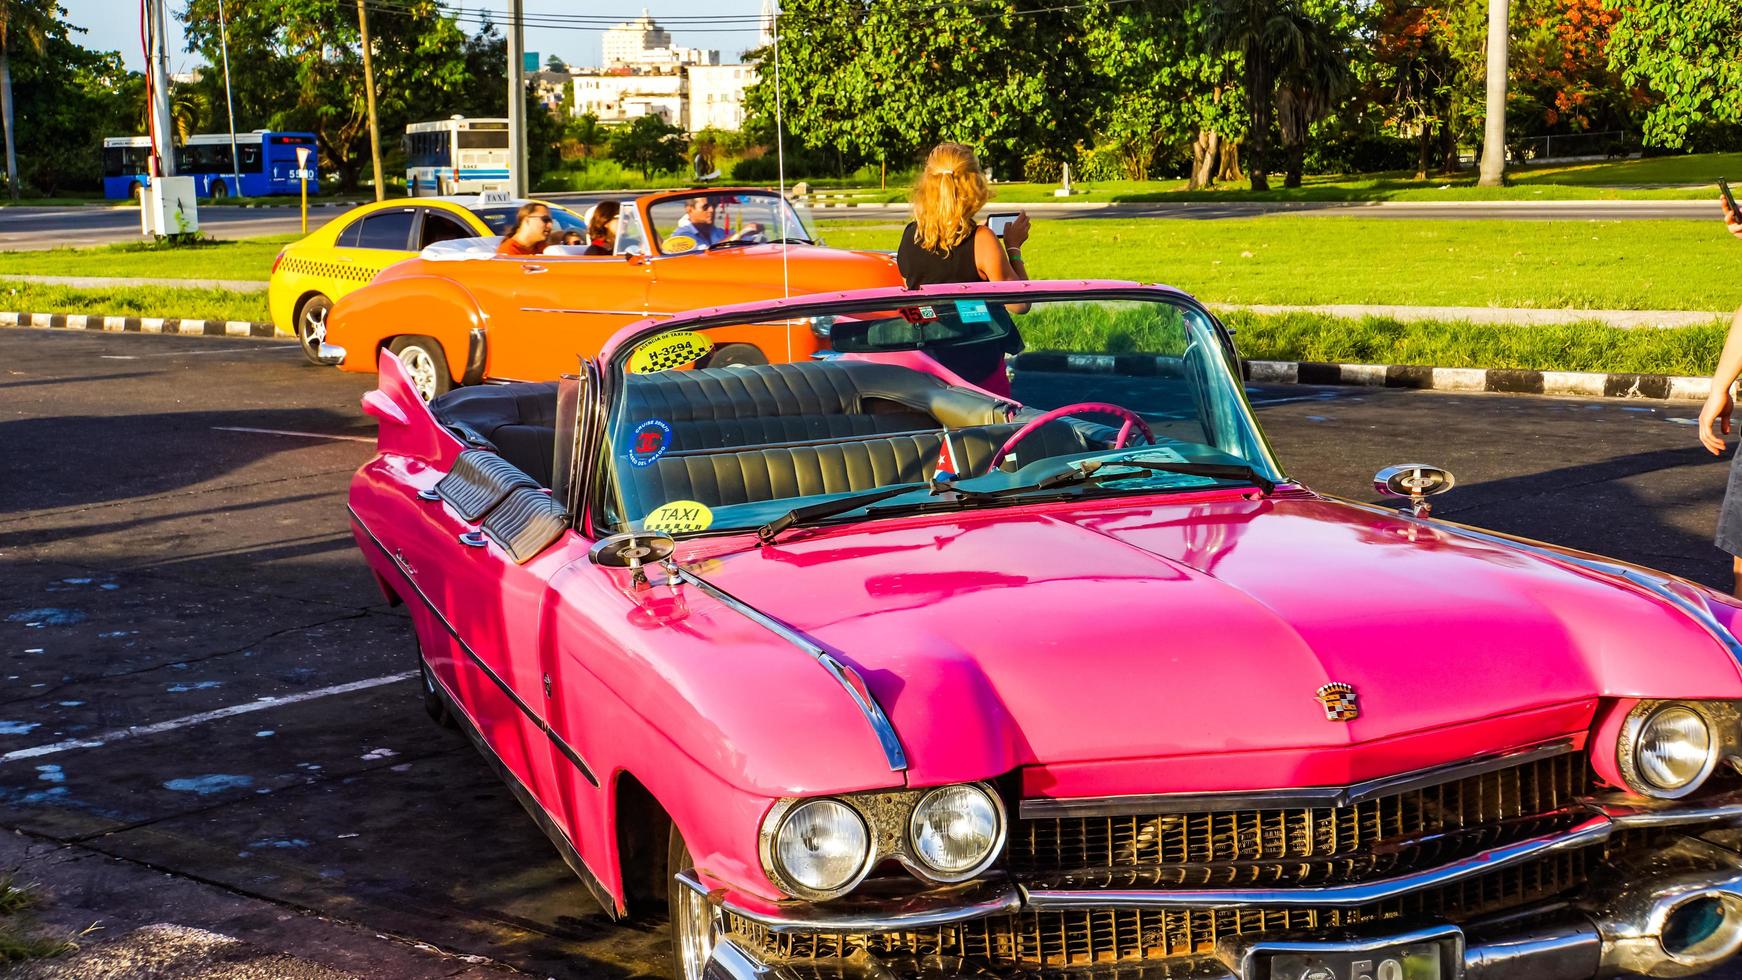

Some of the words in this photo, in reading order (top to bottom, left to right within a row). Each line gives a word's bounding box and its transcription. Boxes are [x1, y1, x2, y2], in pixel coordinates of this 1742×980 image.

[486, 193, 506, 202] TAXI
[649, 341, 692, 361] H-3294
[635, 420, 654, 433] CRUISE
[648, 446, 666, 463] PRADO
[661, 508, 700, 521] TAXI
